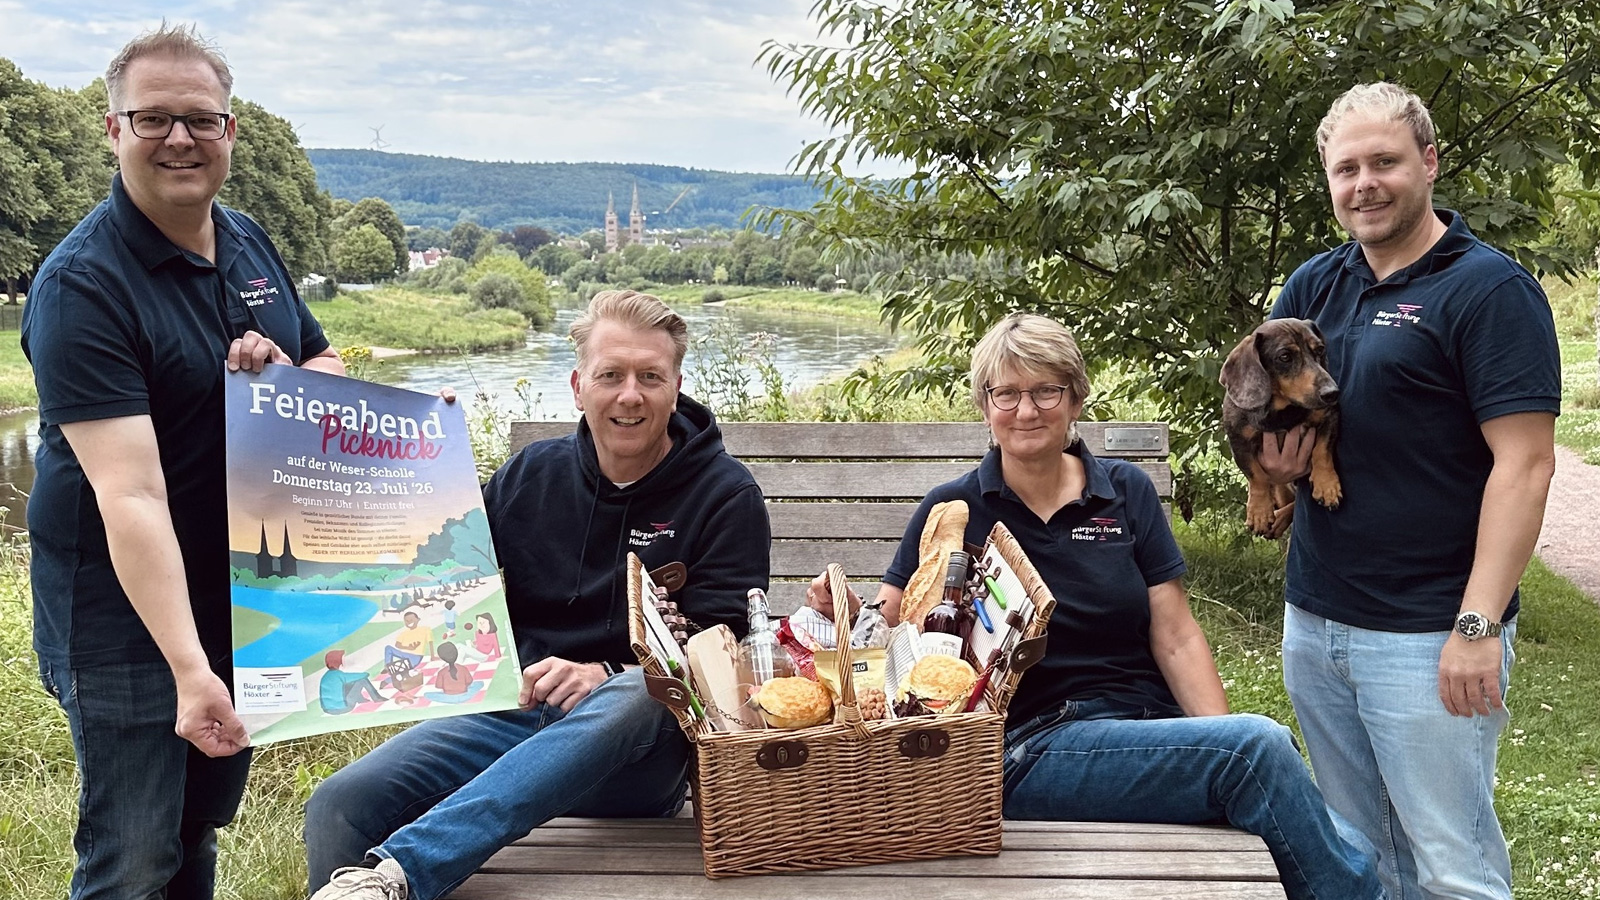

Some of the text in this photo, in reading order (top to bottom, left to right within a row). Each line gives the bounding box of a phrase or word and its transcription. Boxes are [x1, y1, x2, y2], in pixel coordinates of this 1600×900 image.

[249, 382, 447, 440] Feierabend
[318, 413, 442, 460] Picknick
[287, 455, 415, 479] auf der Weser-Scholle
[273, 469, 351, 496] Donnerstag
[355, 481, 376, 495] 23.
[379, 481, 409, 495] Juli
[292, 494, 415, 511] Beginn 17 Uhr Eintritt frei
[1071, 533, 1096, 541] Höxter
[243, 682, 298, 691] BürgerStiftung
